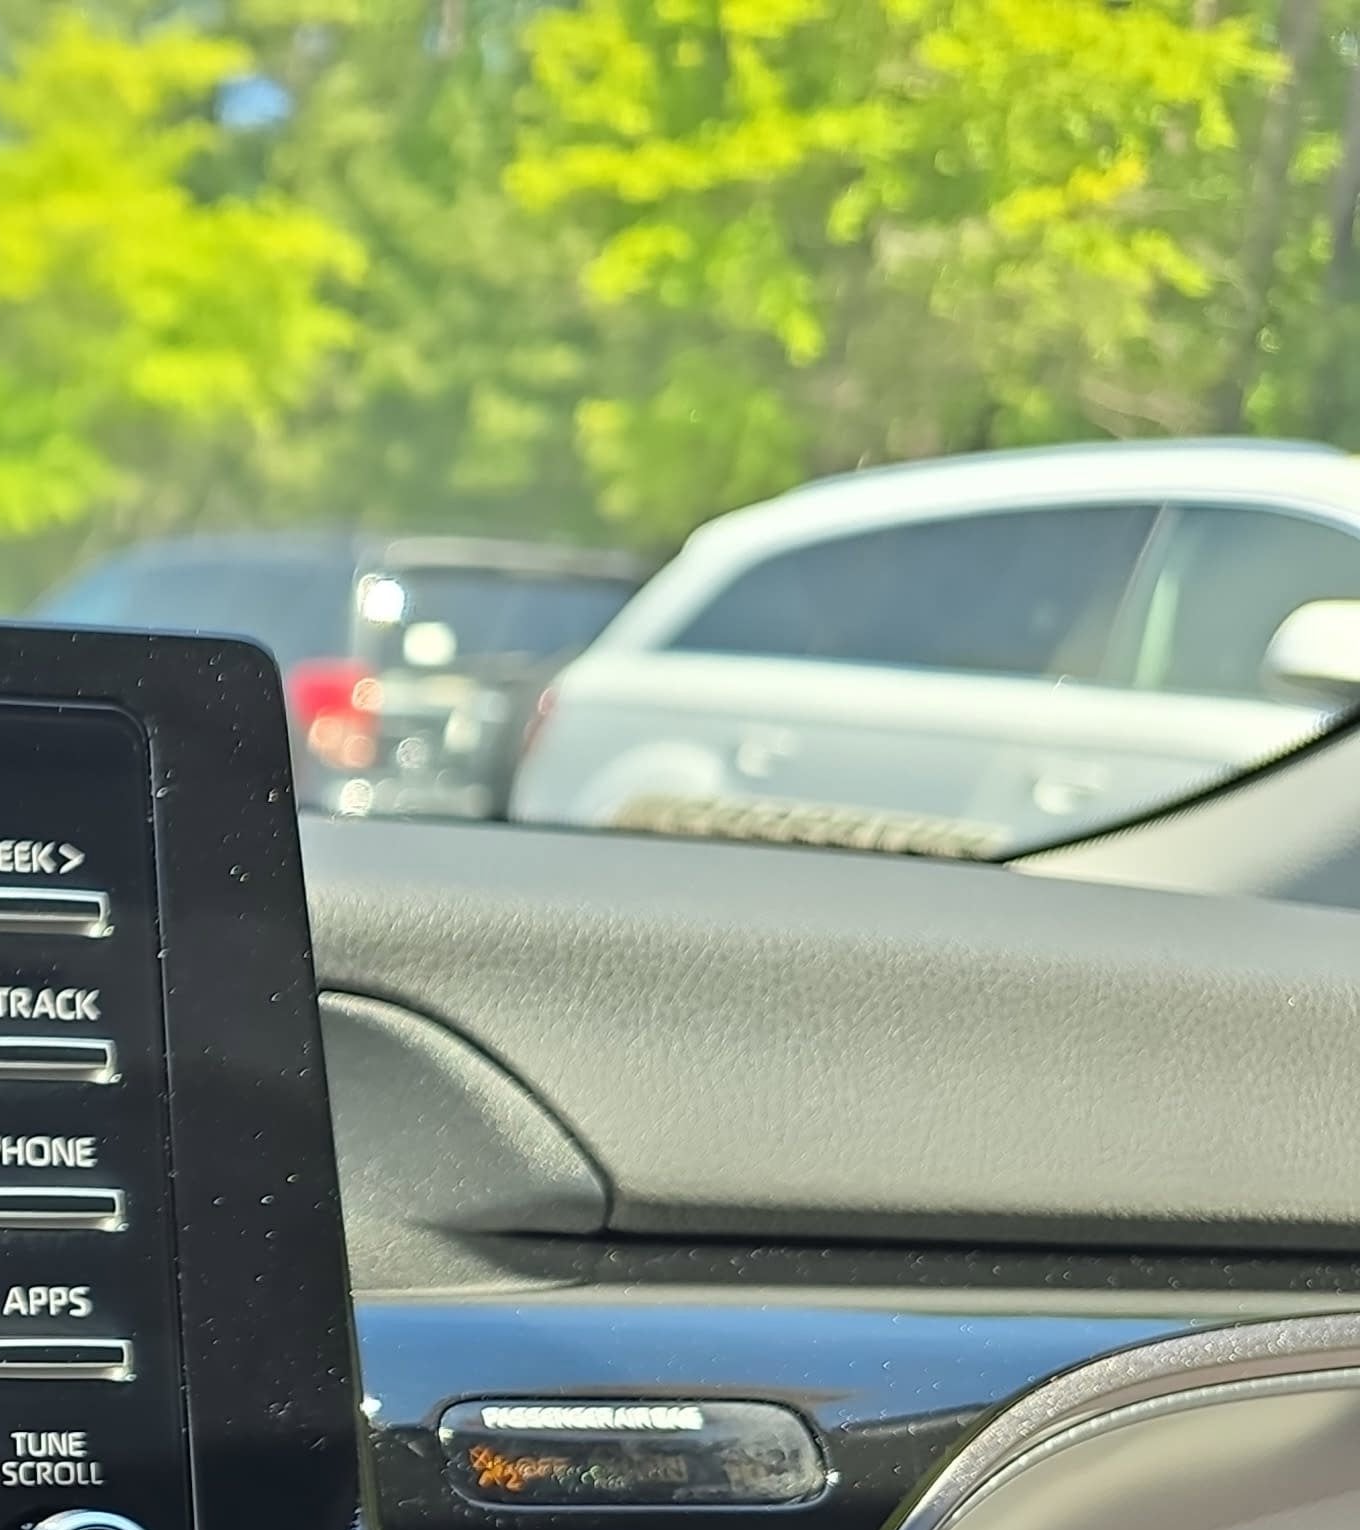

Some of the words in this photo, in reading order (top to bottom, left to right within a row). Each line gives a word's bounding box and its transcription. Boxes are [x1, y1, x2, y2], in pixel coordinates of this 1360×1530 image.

[2, 1286, 92, 1317] APPS
[10, 1430, 87, 1457] TUNE
[1, 1460, 103, 1486] SCROLL
